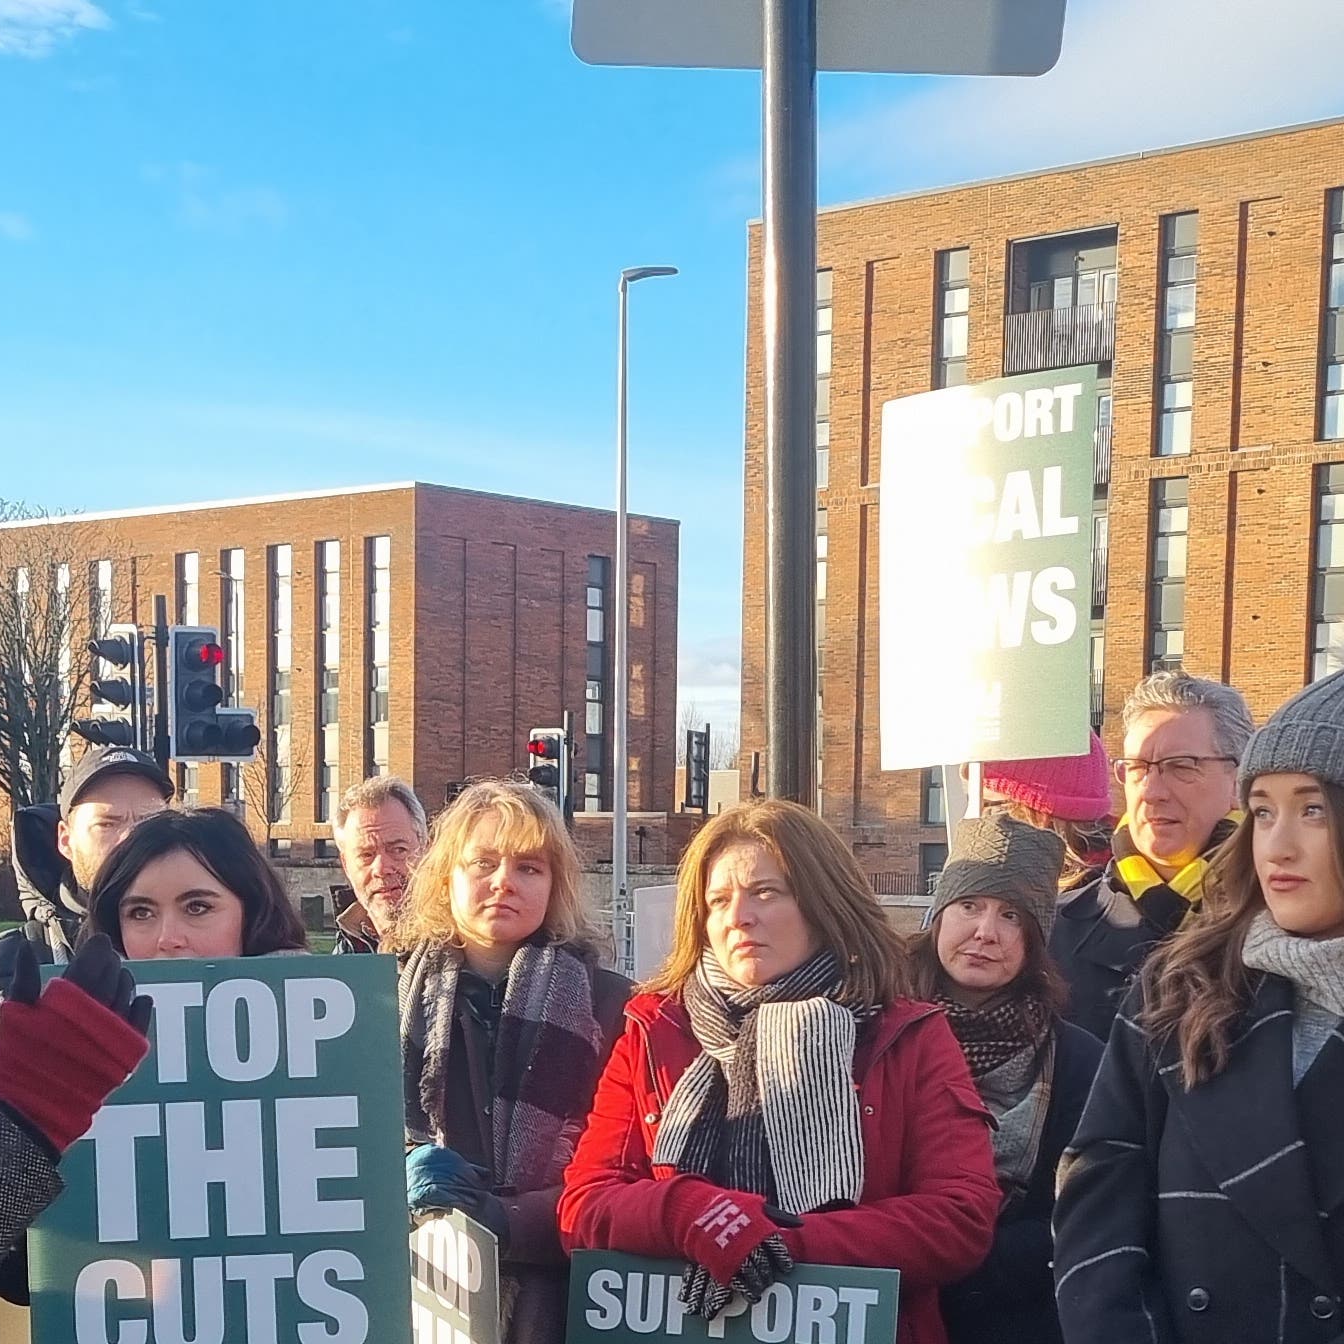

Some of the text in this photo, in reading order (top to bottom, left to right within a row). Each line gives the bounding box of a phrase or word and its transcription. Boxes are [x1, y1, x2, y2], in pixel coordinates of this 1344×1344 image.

[126, 977, 356, 1084] TOP
[79, 1095, 366, 1243] THE
[417, 1218, 482, 1321] TOP
